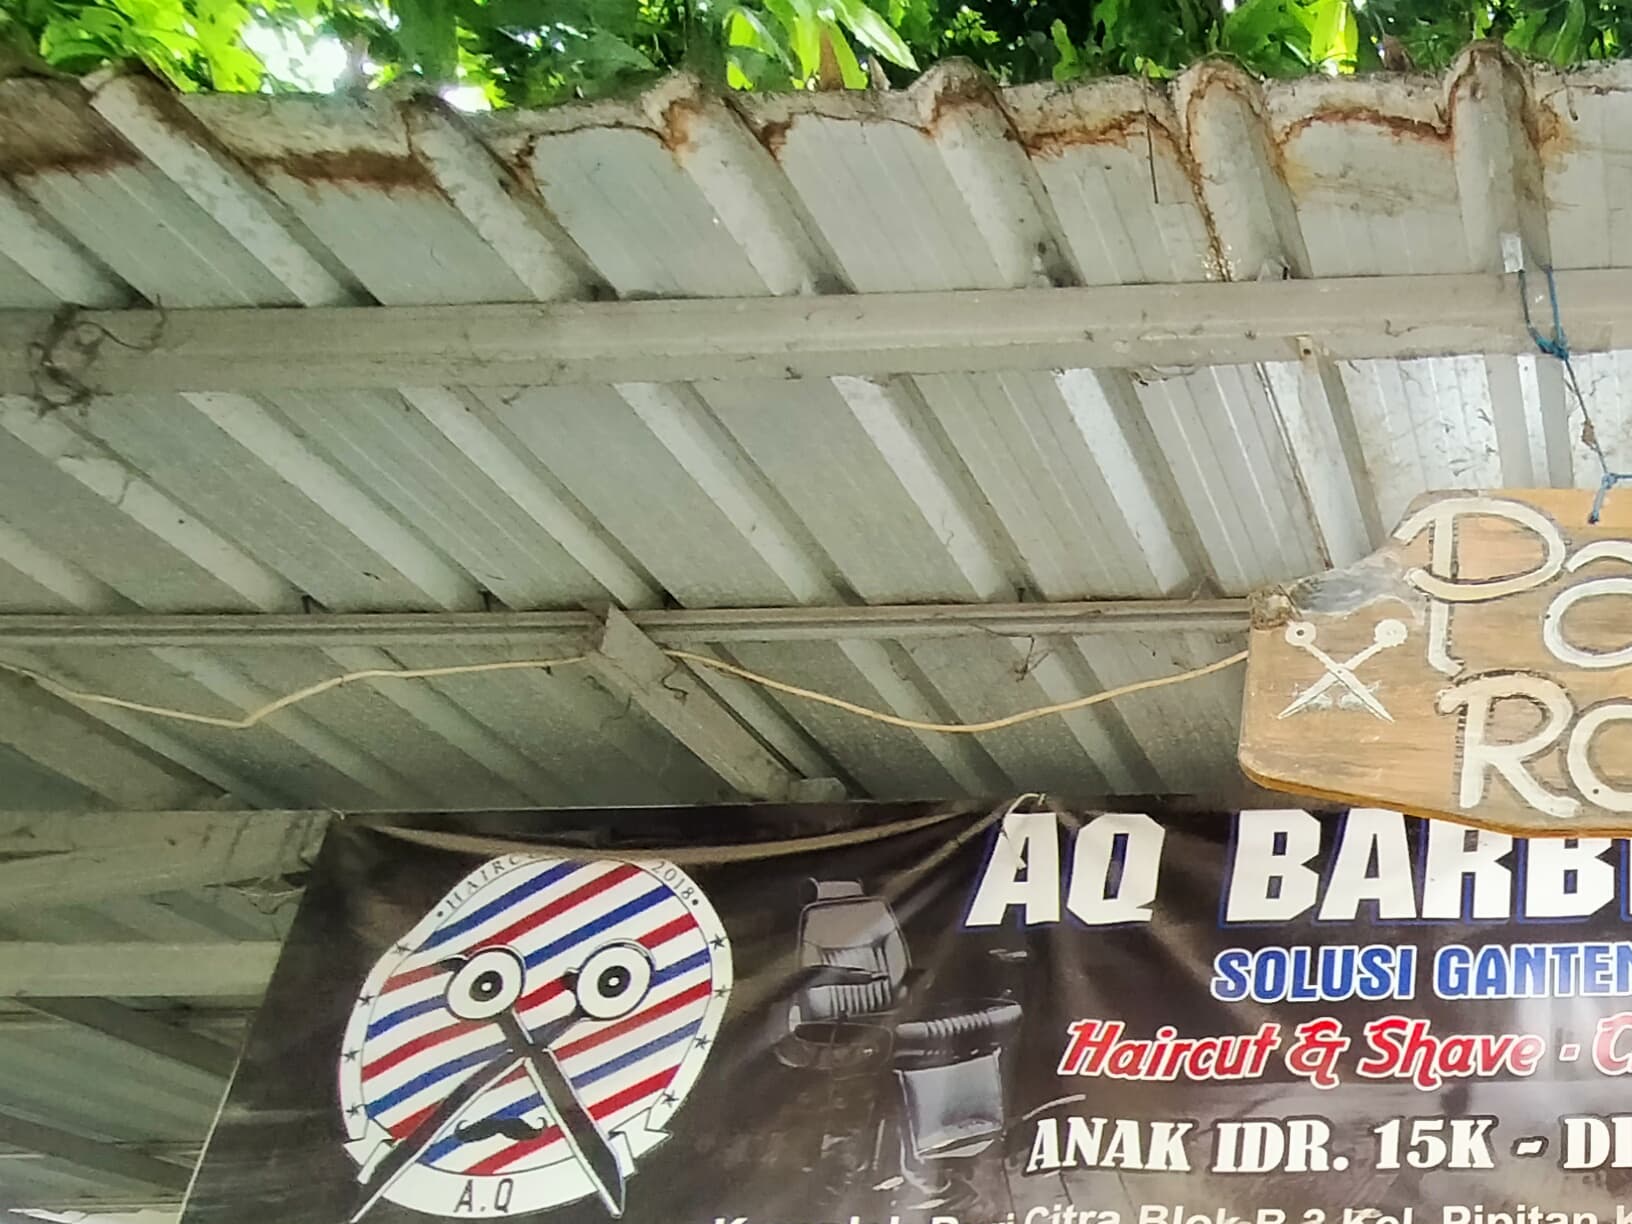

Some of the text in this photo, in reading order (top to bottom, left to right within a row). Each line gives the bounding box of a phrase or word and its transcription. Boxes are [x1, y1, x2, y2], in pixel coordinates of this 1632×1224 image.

[447, 852, 536, 910] HAIRC
[650, 859, 694, 901] 2018
[963, 811, 1167, 927] AQ
[1210, 945, 1417, 1002] SOLUSI
[1057, 1017, 1282, 1083] Haircut
[1284, 1016, 1351, 1090] &
[1356, 1015, 1546, 1092] Shave
[1022, 1116, 1194, 1173] ANAK
[1211, 1114, 1350, 1172] IDR.
[1371, 1116, 1499, 1170] 15K
[452, 1177, 514, 1214] A.Q
